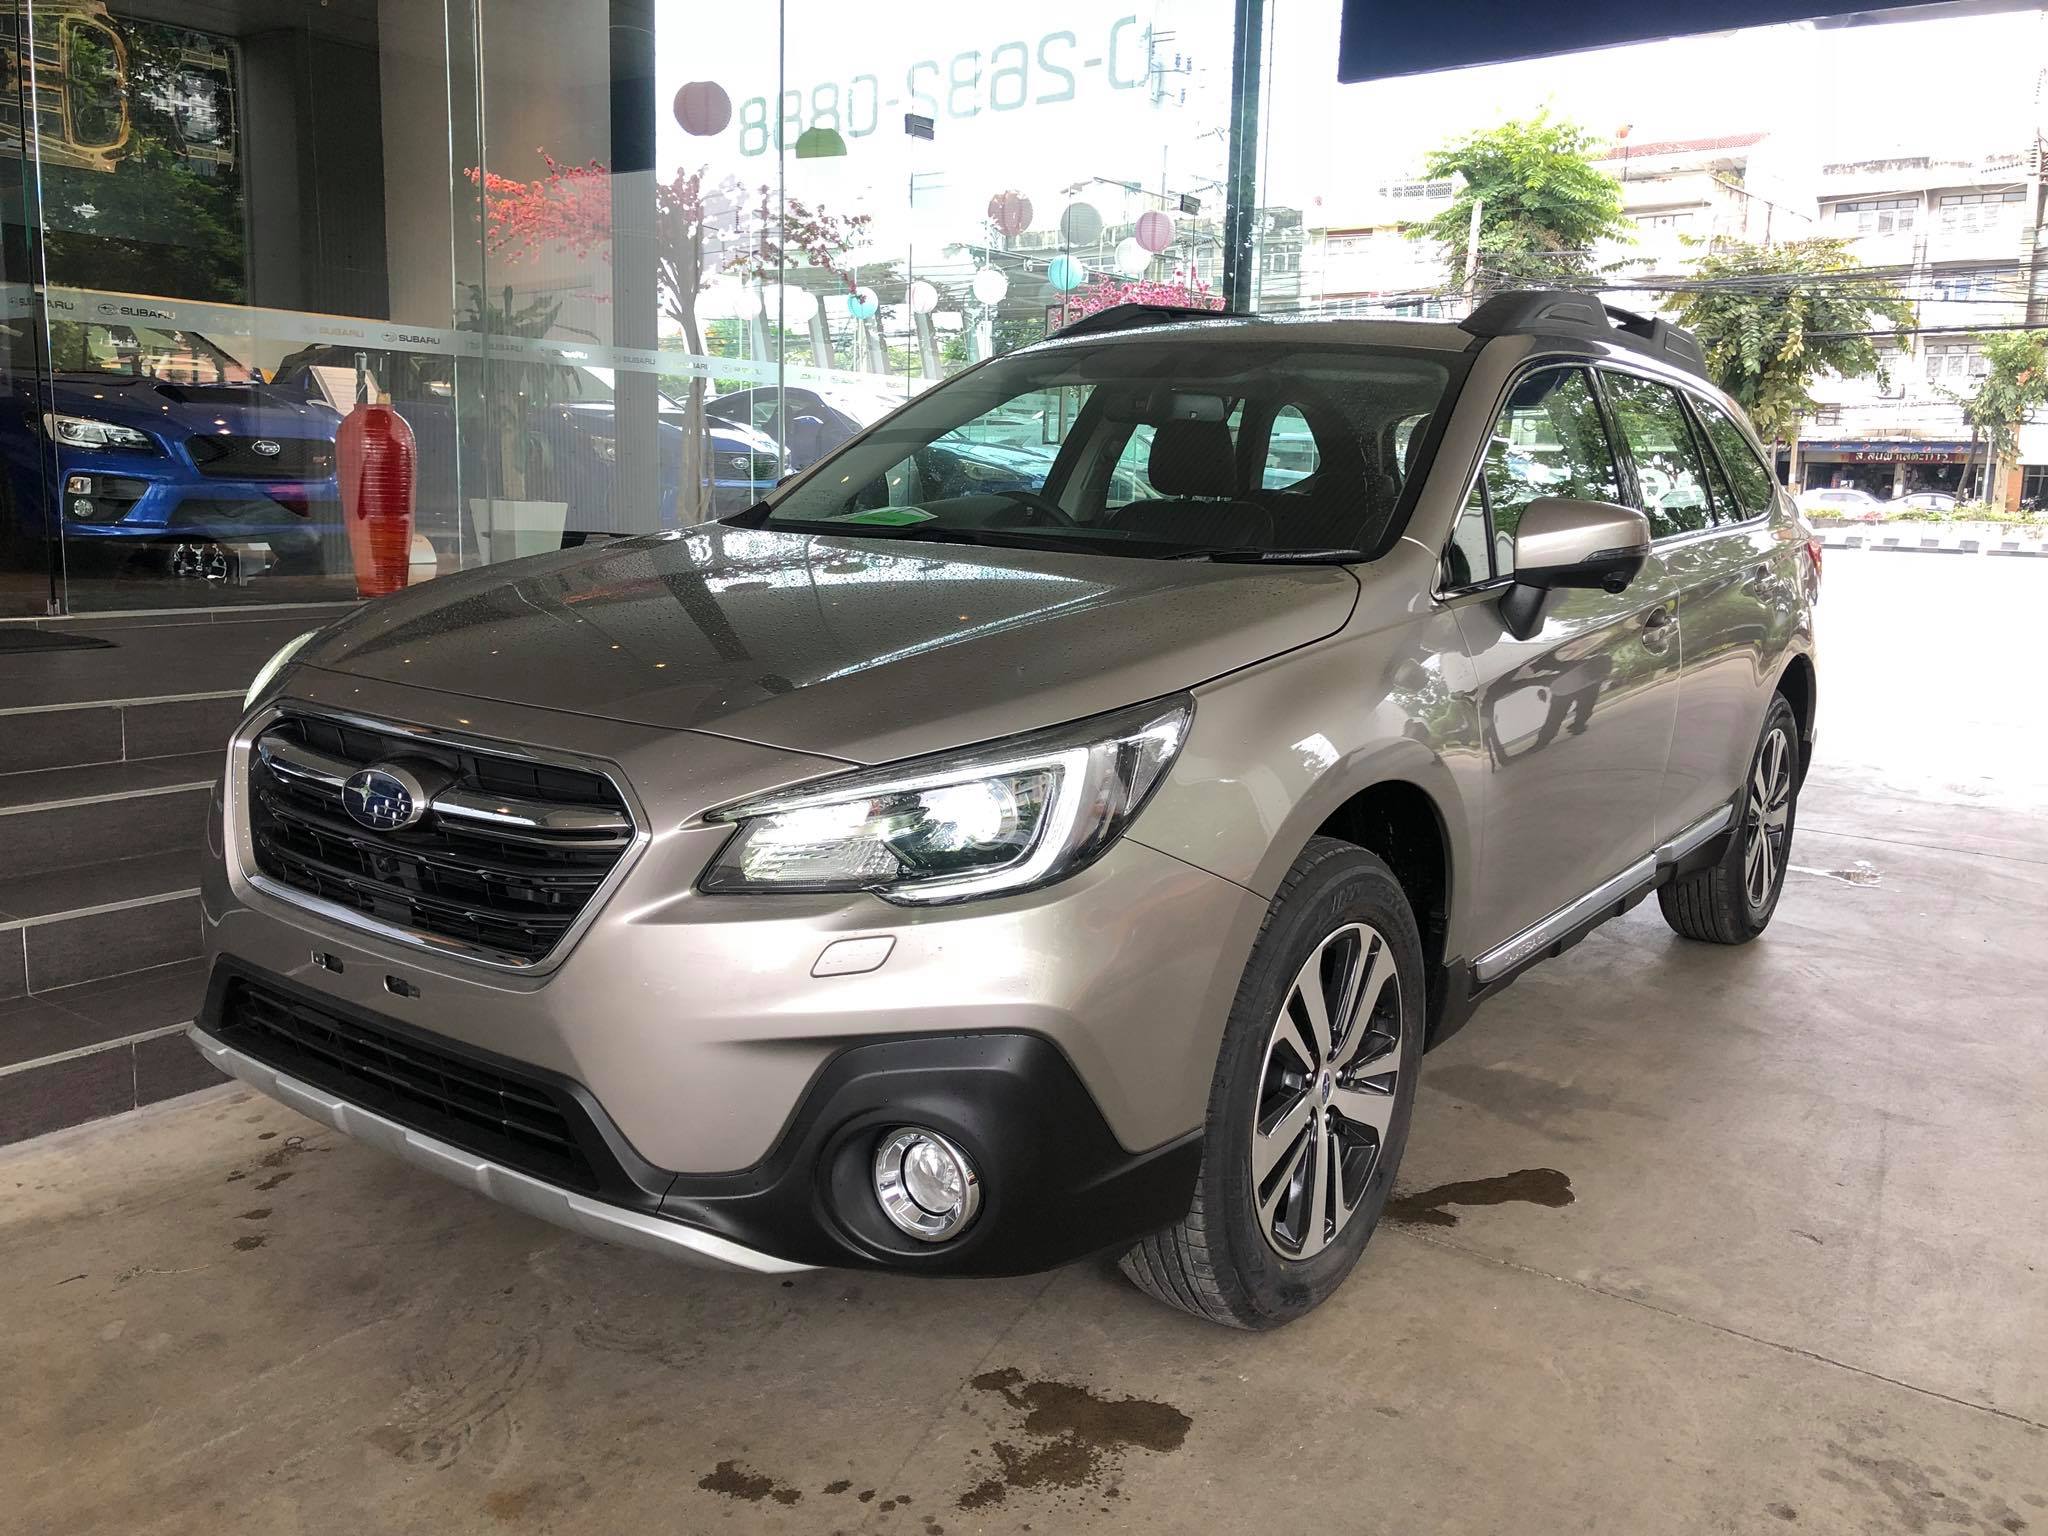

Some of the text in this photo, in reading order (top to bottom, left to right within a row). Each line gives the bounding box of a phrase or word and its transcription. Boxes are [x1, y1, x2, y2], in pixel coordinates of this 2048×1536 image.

[120, 306, 176, 320] SUBARU
[320, 327, 364, 338] SUBARU
[398, 334, 440, 345] SUBARU
[623, 356, 656, 366] SUBARU
